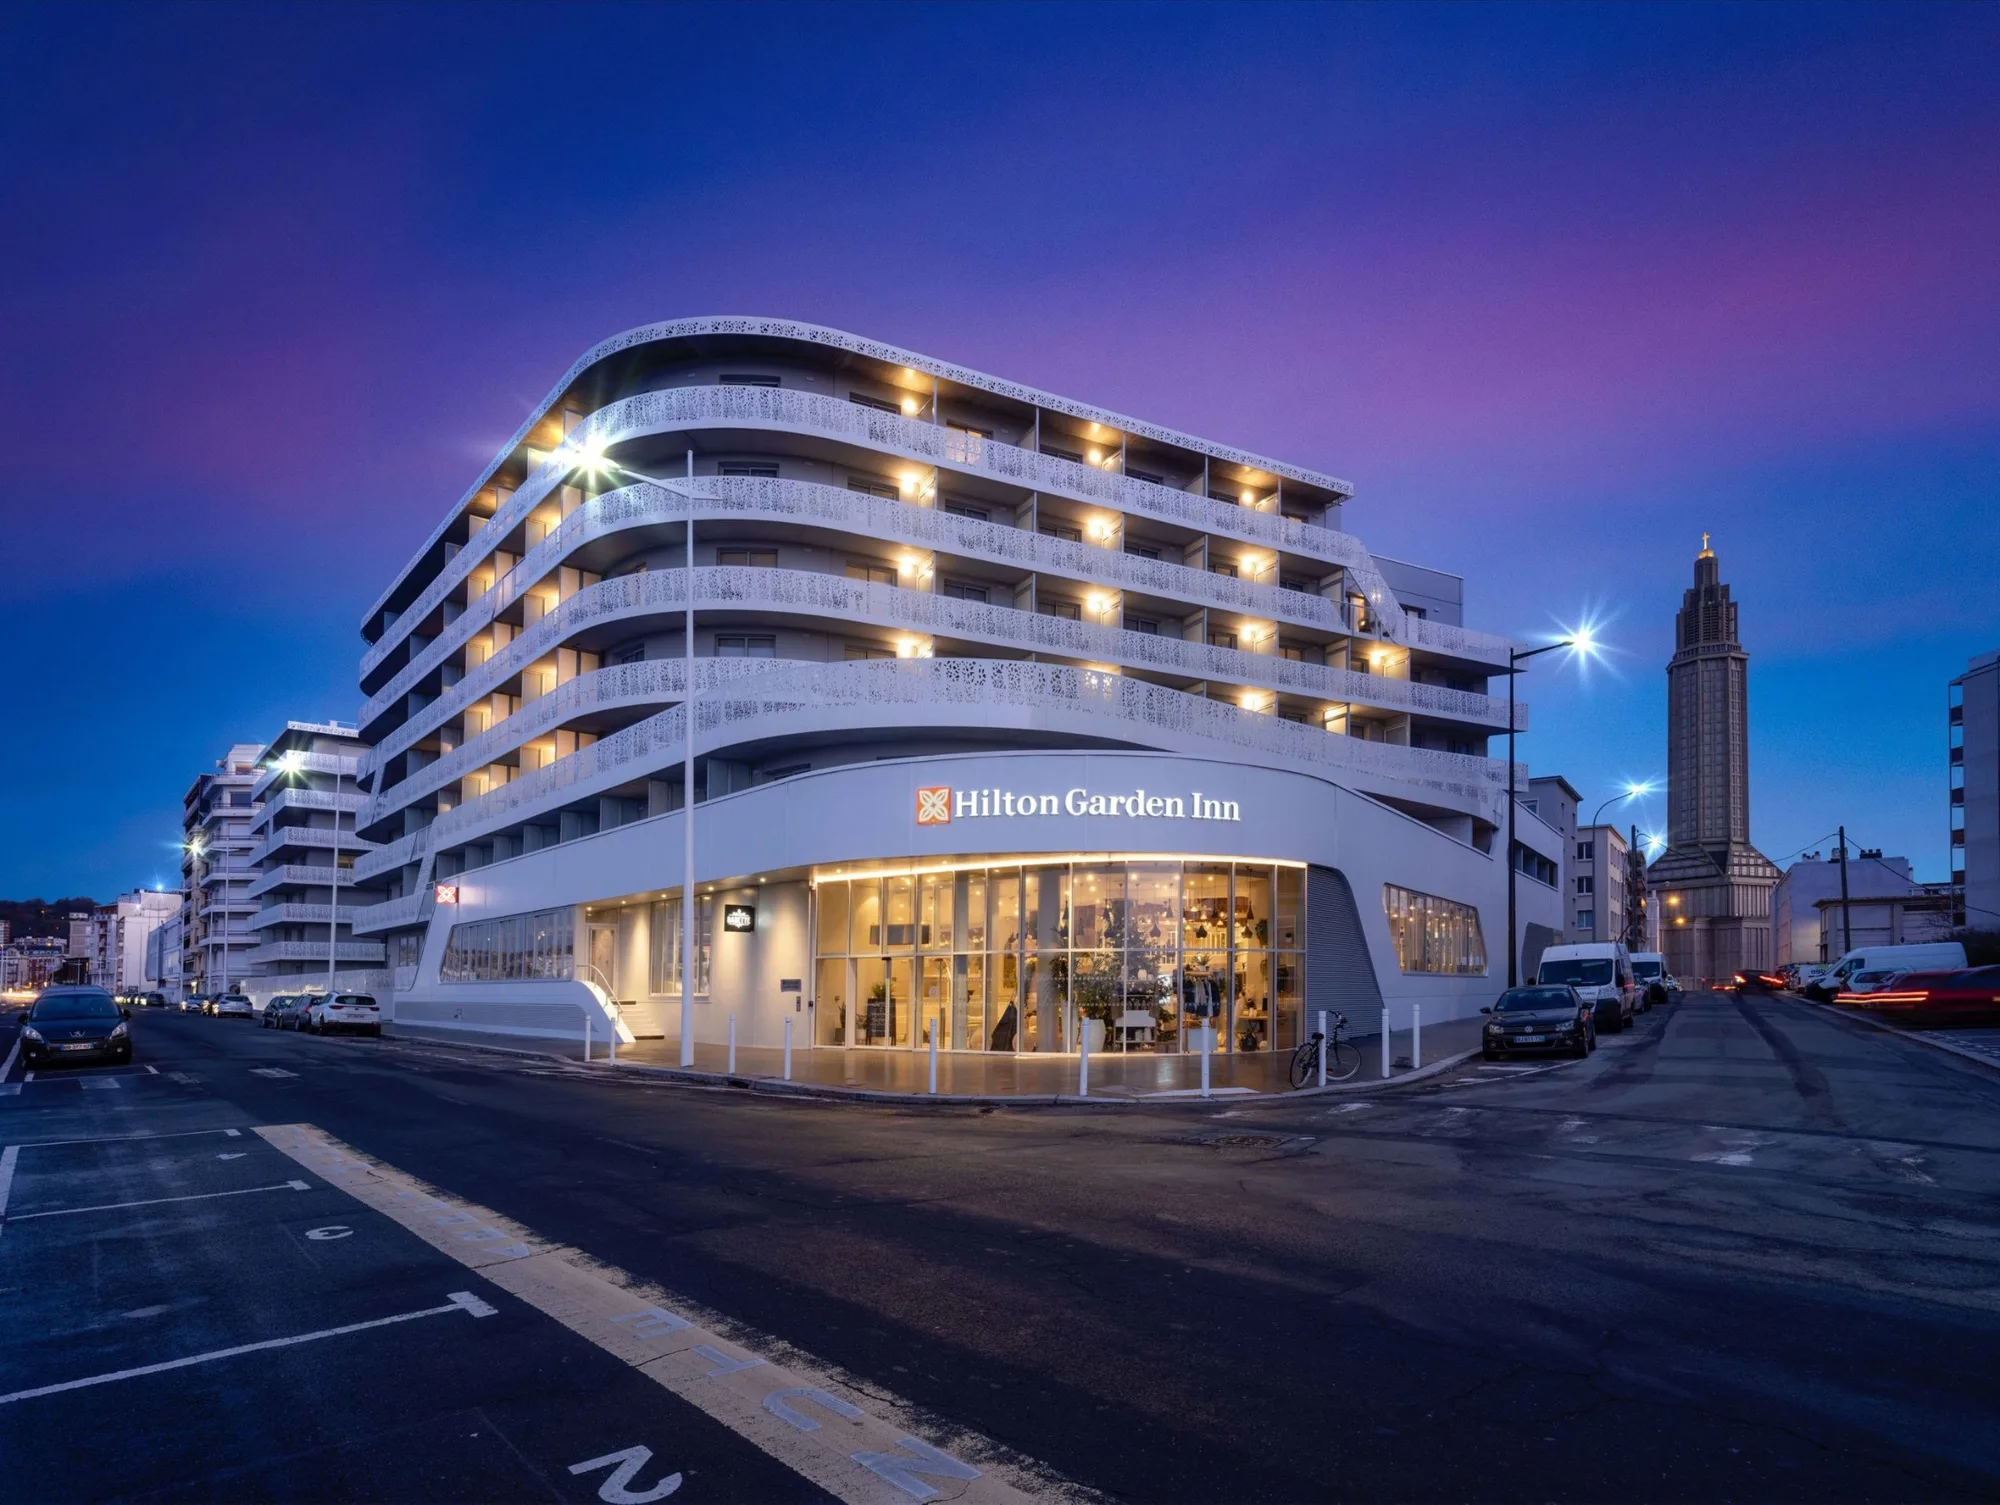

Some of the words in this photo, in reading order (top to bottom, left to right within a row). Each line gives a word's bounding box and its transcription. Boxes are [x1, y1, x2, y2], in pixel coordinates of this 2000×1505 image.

[955, 789, 1059, 817] Hilton
[1064, 788, 1185, 818] Garden
[1190, 792, 1241, 821] Inn
[305, 1226, 354, 1240] 3
[567, 1445, 683, 1505] 2
